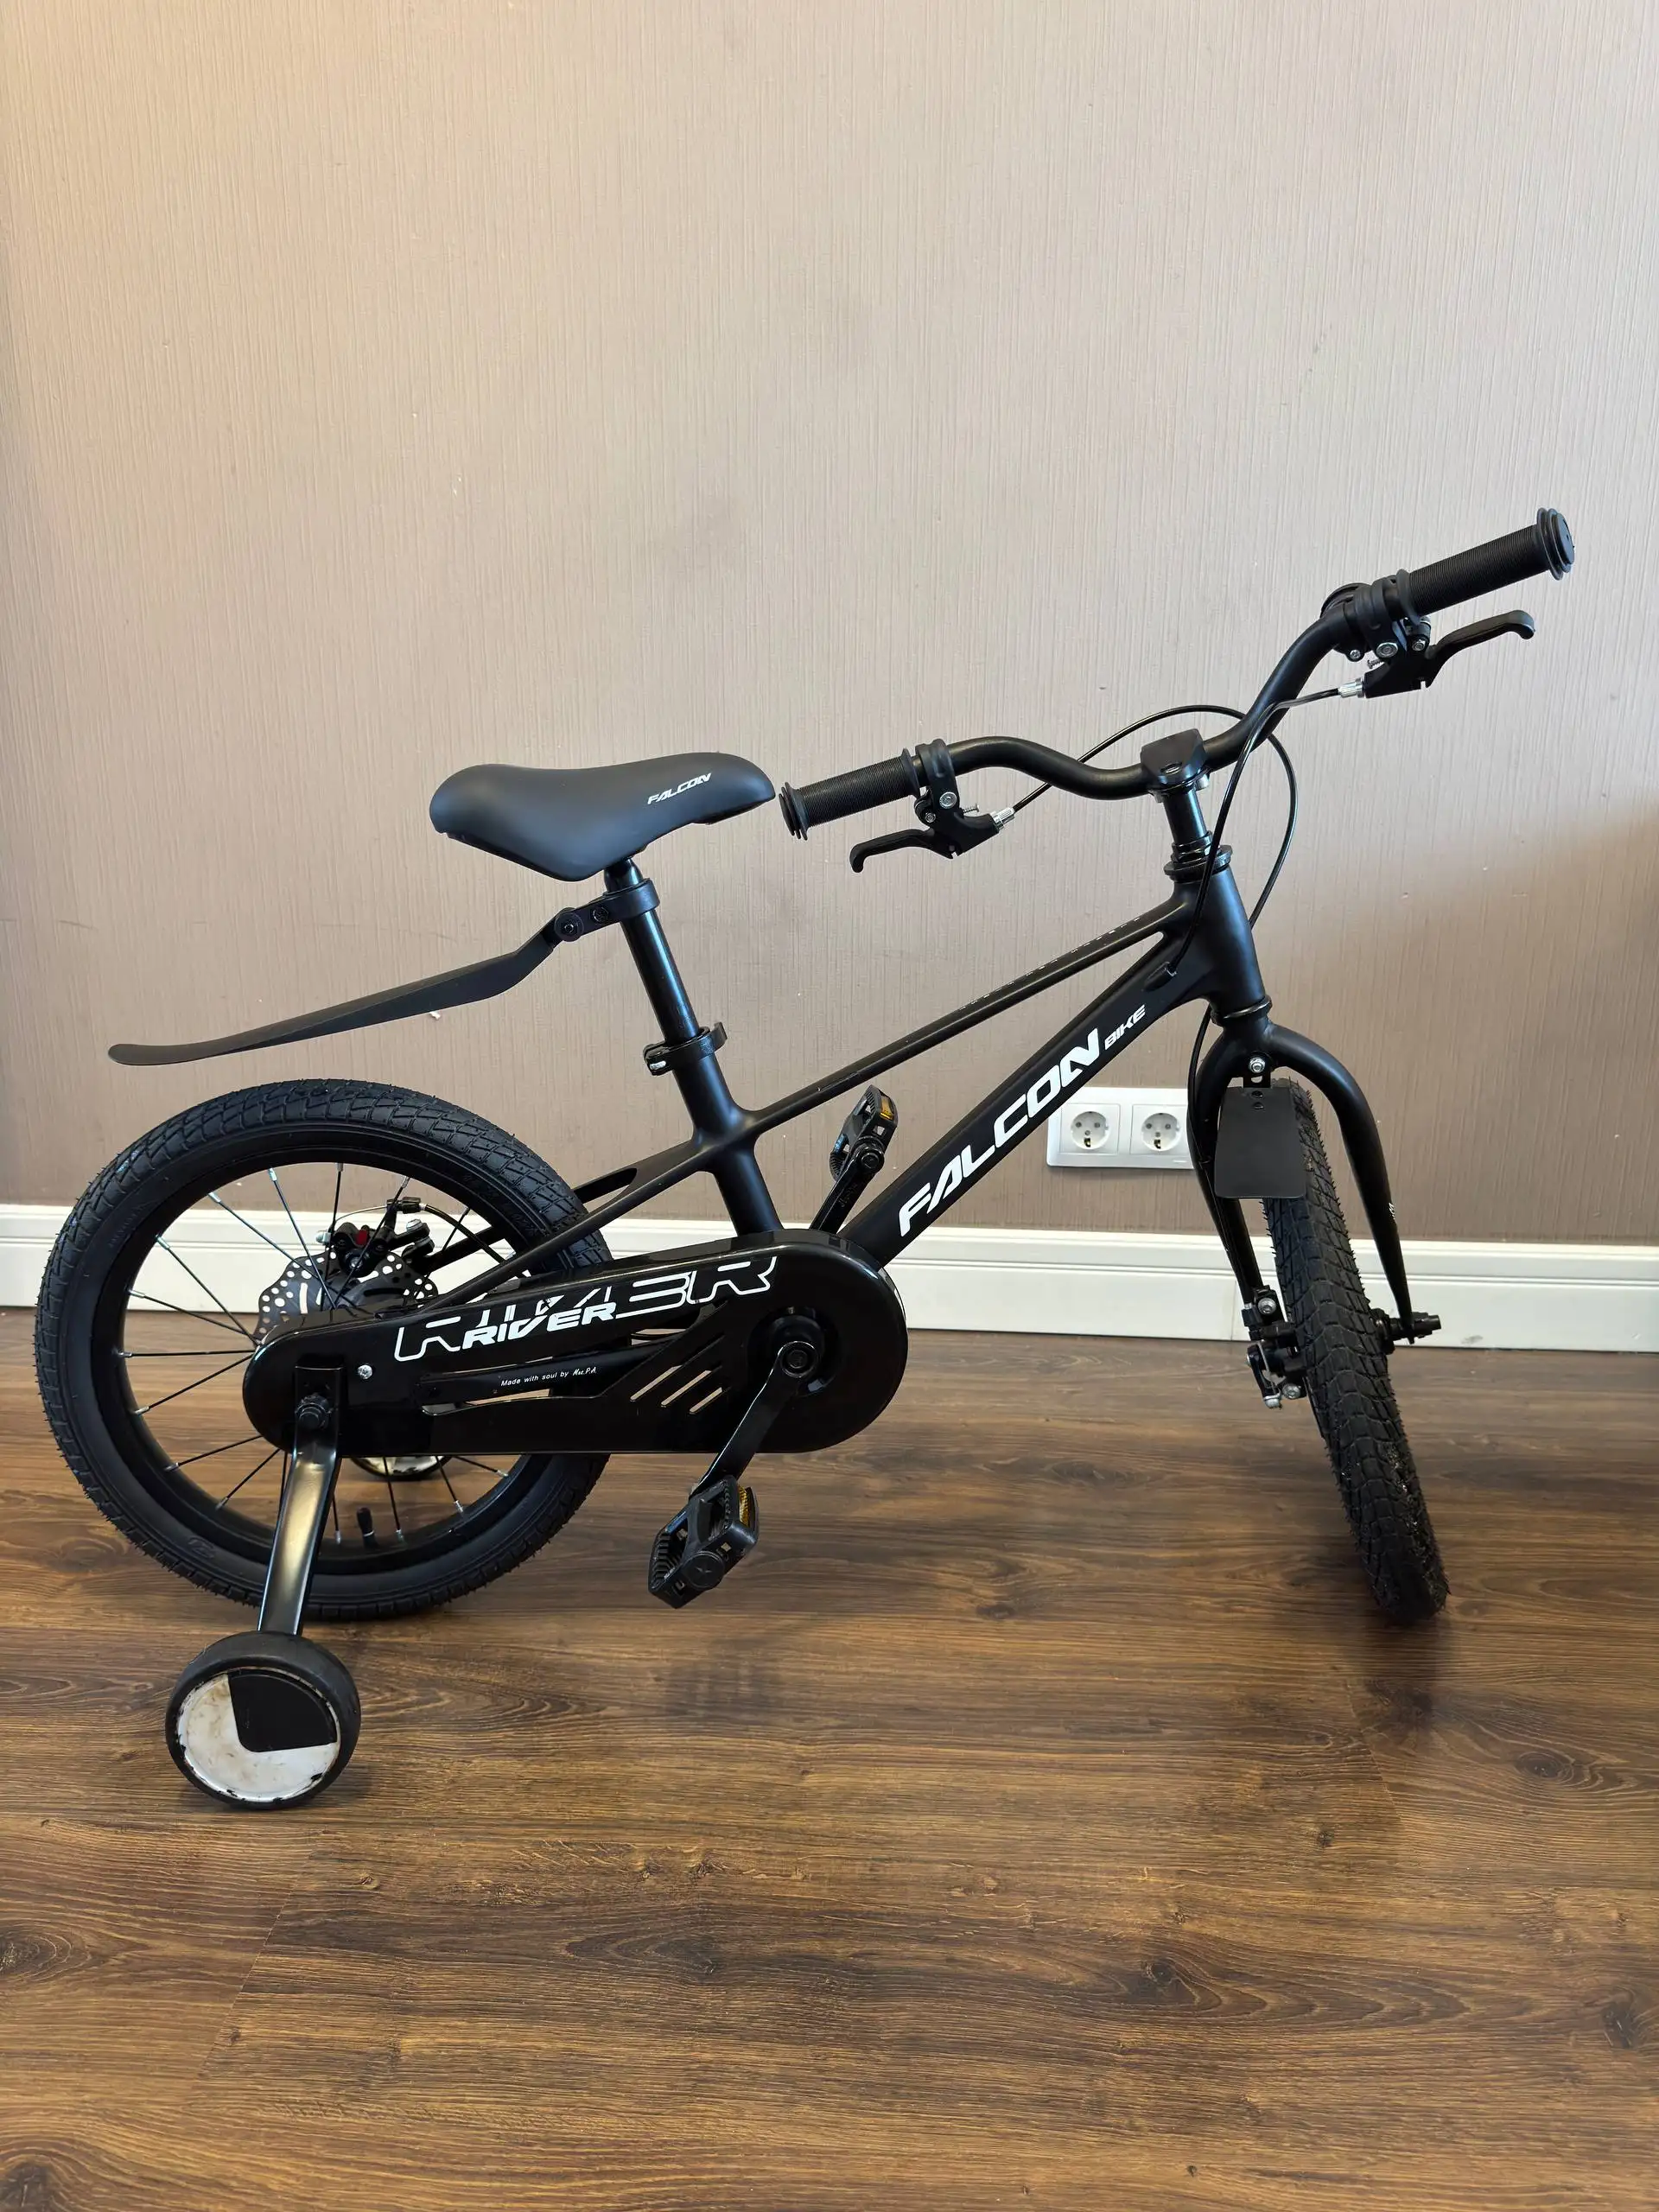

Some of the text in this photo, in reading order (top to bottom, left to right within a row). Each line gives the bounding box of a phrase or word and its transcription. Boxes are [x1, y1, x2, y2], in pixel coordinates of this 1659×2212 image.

[647, 772, 712, 804] FALCON
[899, 1004, 1147, 1237] FALCON BIKE
[462, 1302, 617, 1350] RIVER
